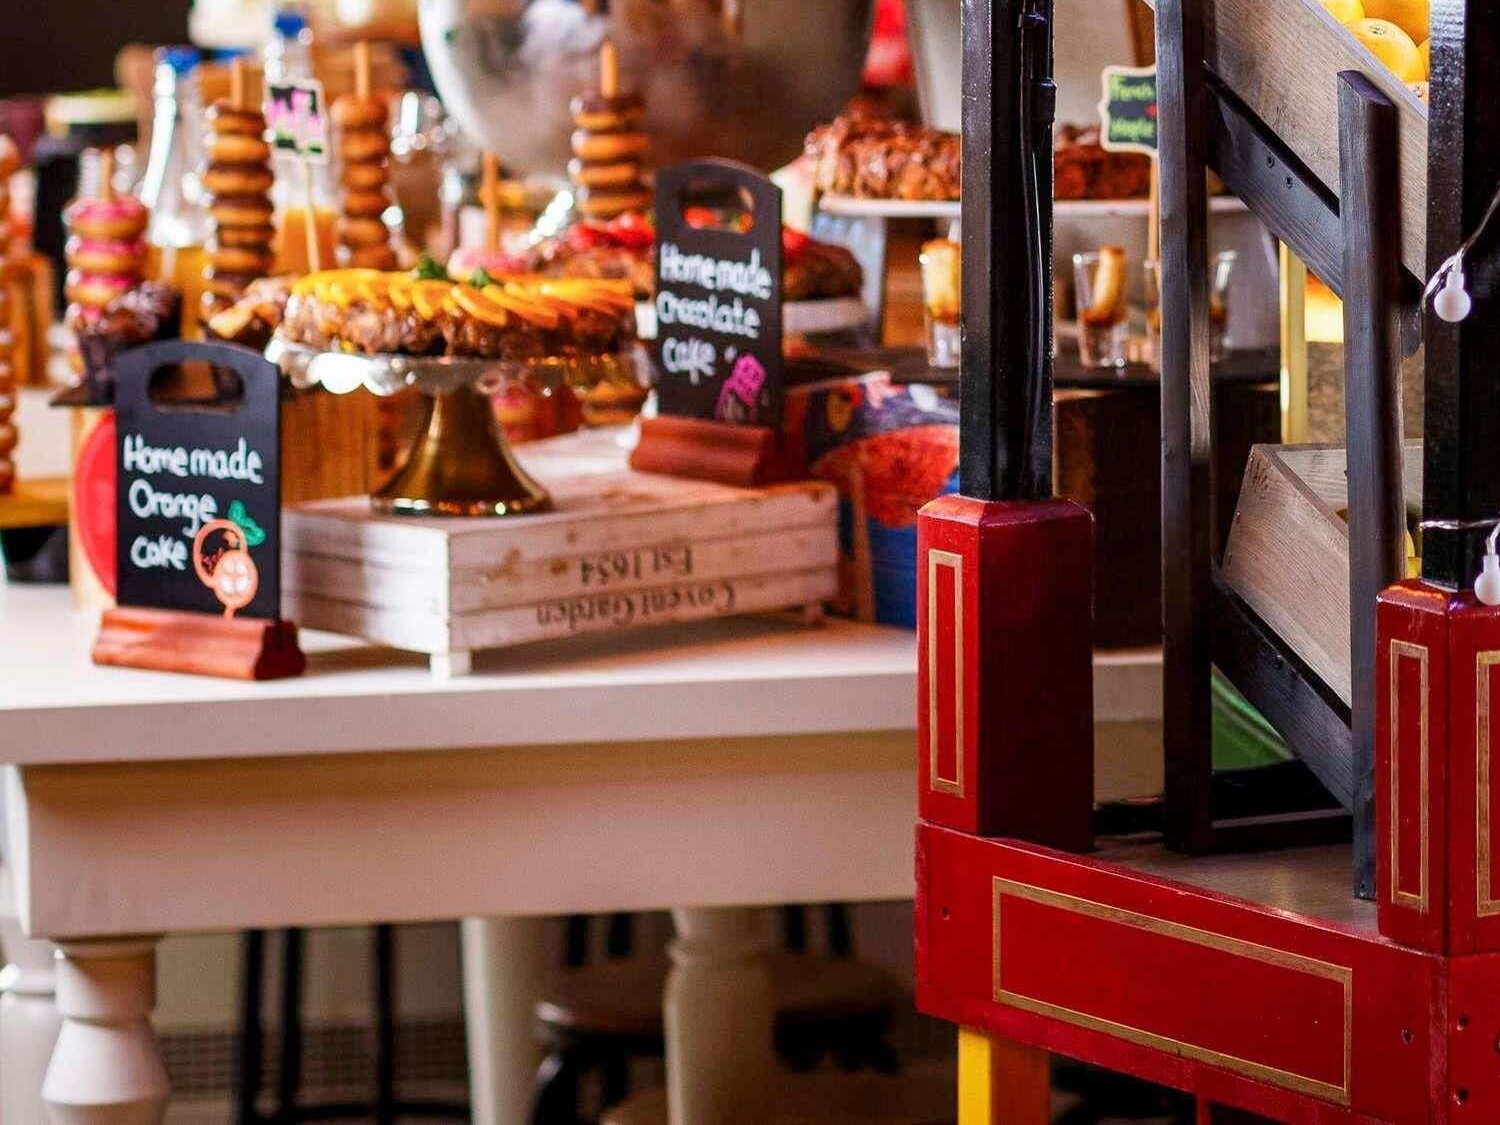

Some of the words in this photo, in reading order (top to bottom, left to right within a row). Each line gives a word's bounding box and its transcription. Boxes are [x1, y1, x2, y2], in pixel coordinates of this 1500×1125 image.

[659, 241, 773, 301] Homemade
[128, 477, 219, 538] Orange
[536, 593, 635, 630] Garden
[640, 578, 737, 617] Covent
